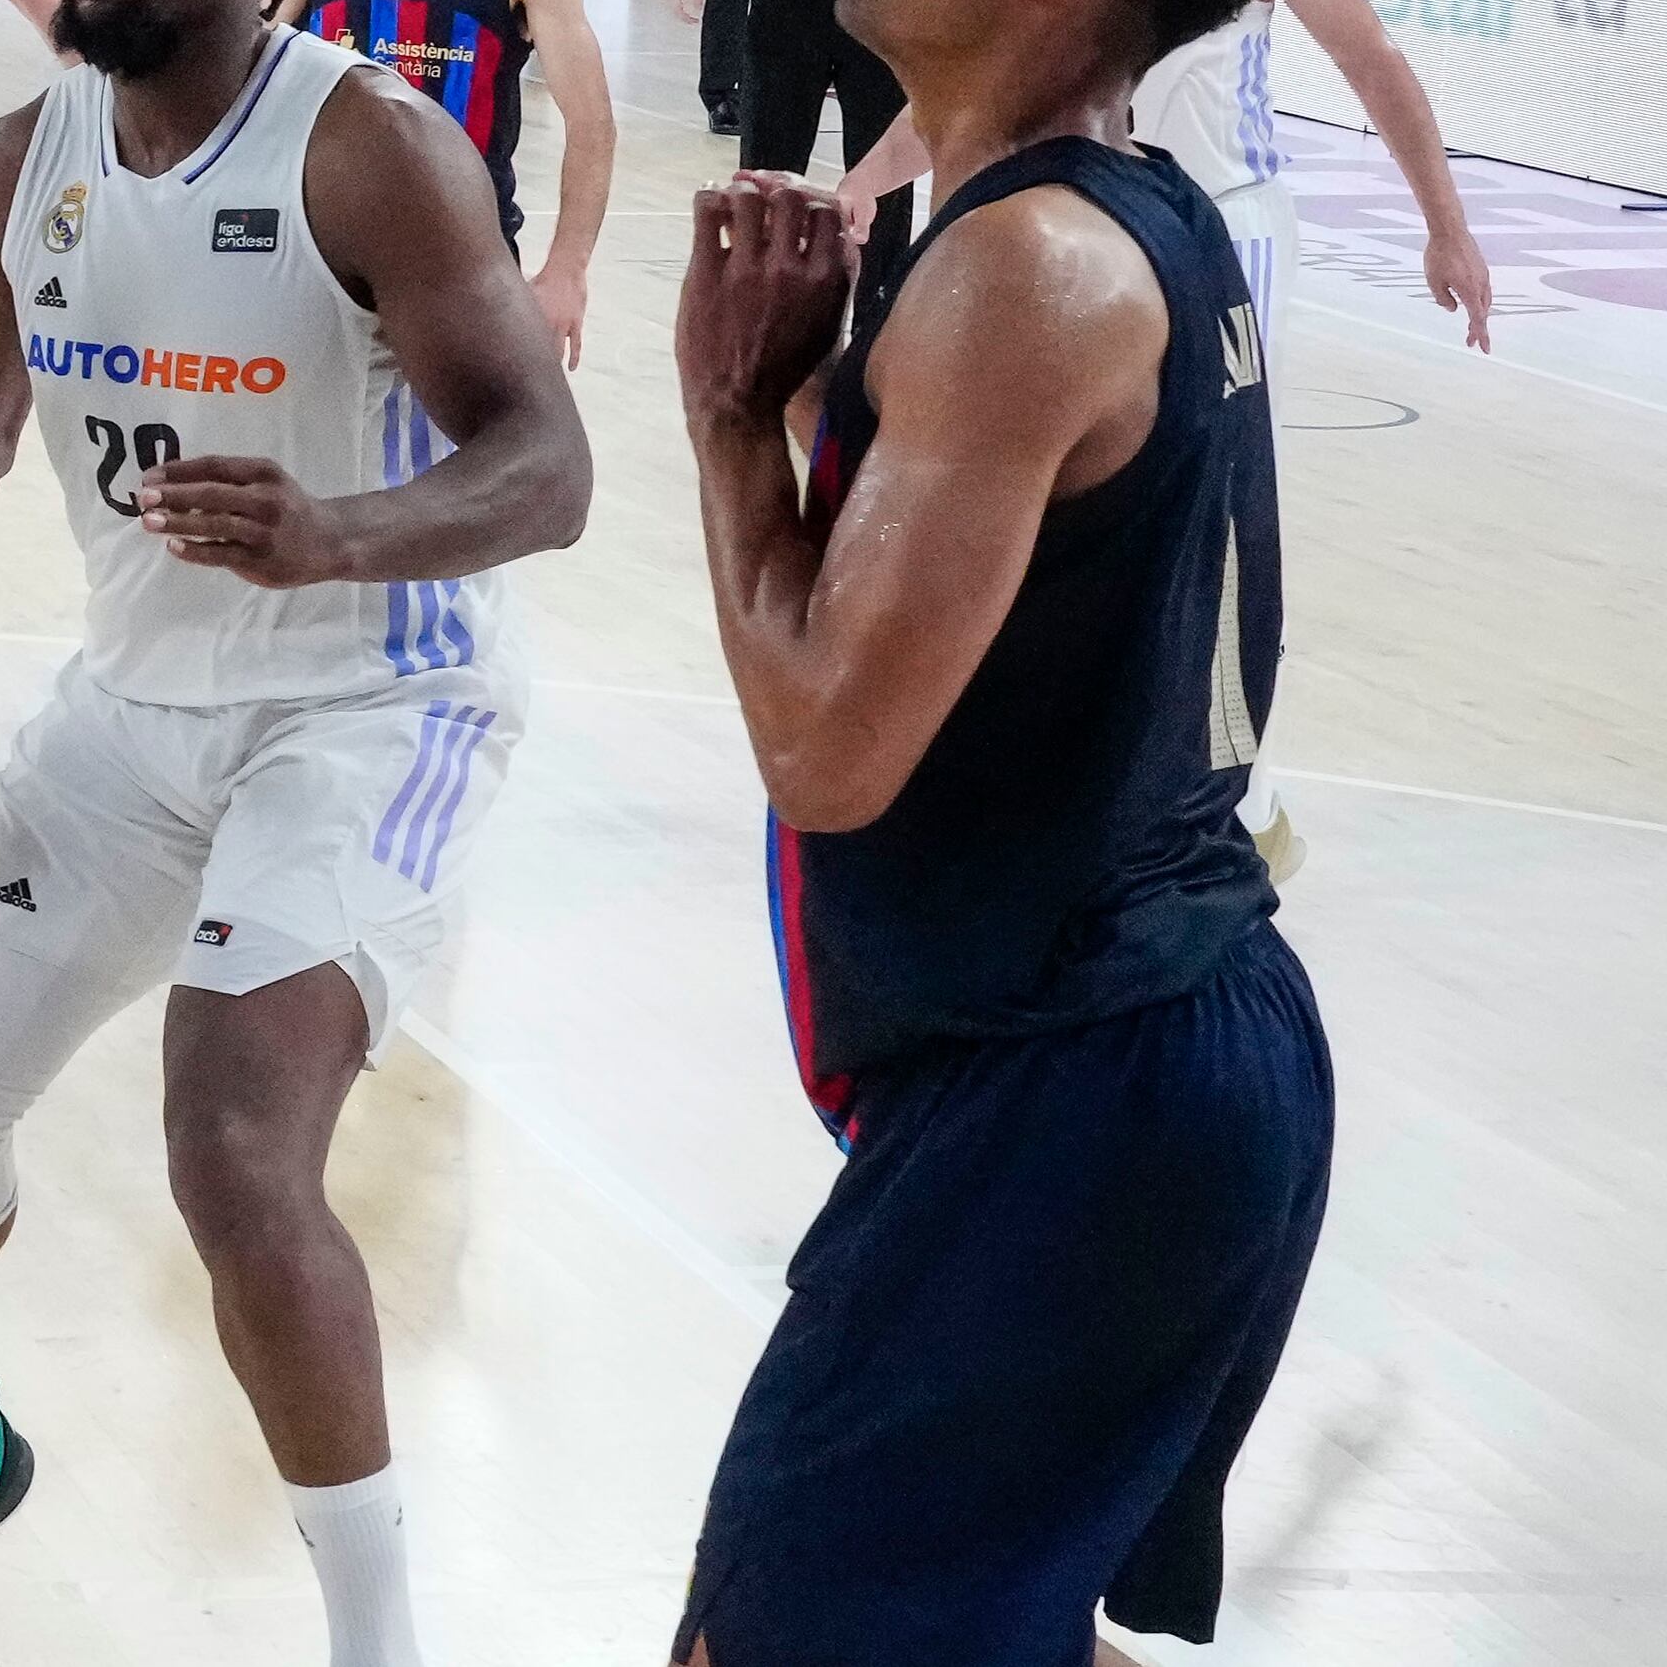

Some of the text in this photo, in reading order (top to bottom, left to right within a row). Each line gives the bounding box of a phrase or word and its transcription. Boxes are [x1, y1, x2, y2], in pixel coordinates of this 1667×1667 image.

[373, 37, 475, 63] Assistència
[218, 222, 245, 237] liga
[216, 235, 274, 249] endesa
[27, 334, 286, 394] AUTOHERO
[195, 928, 220, 943] acb
